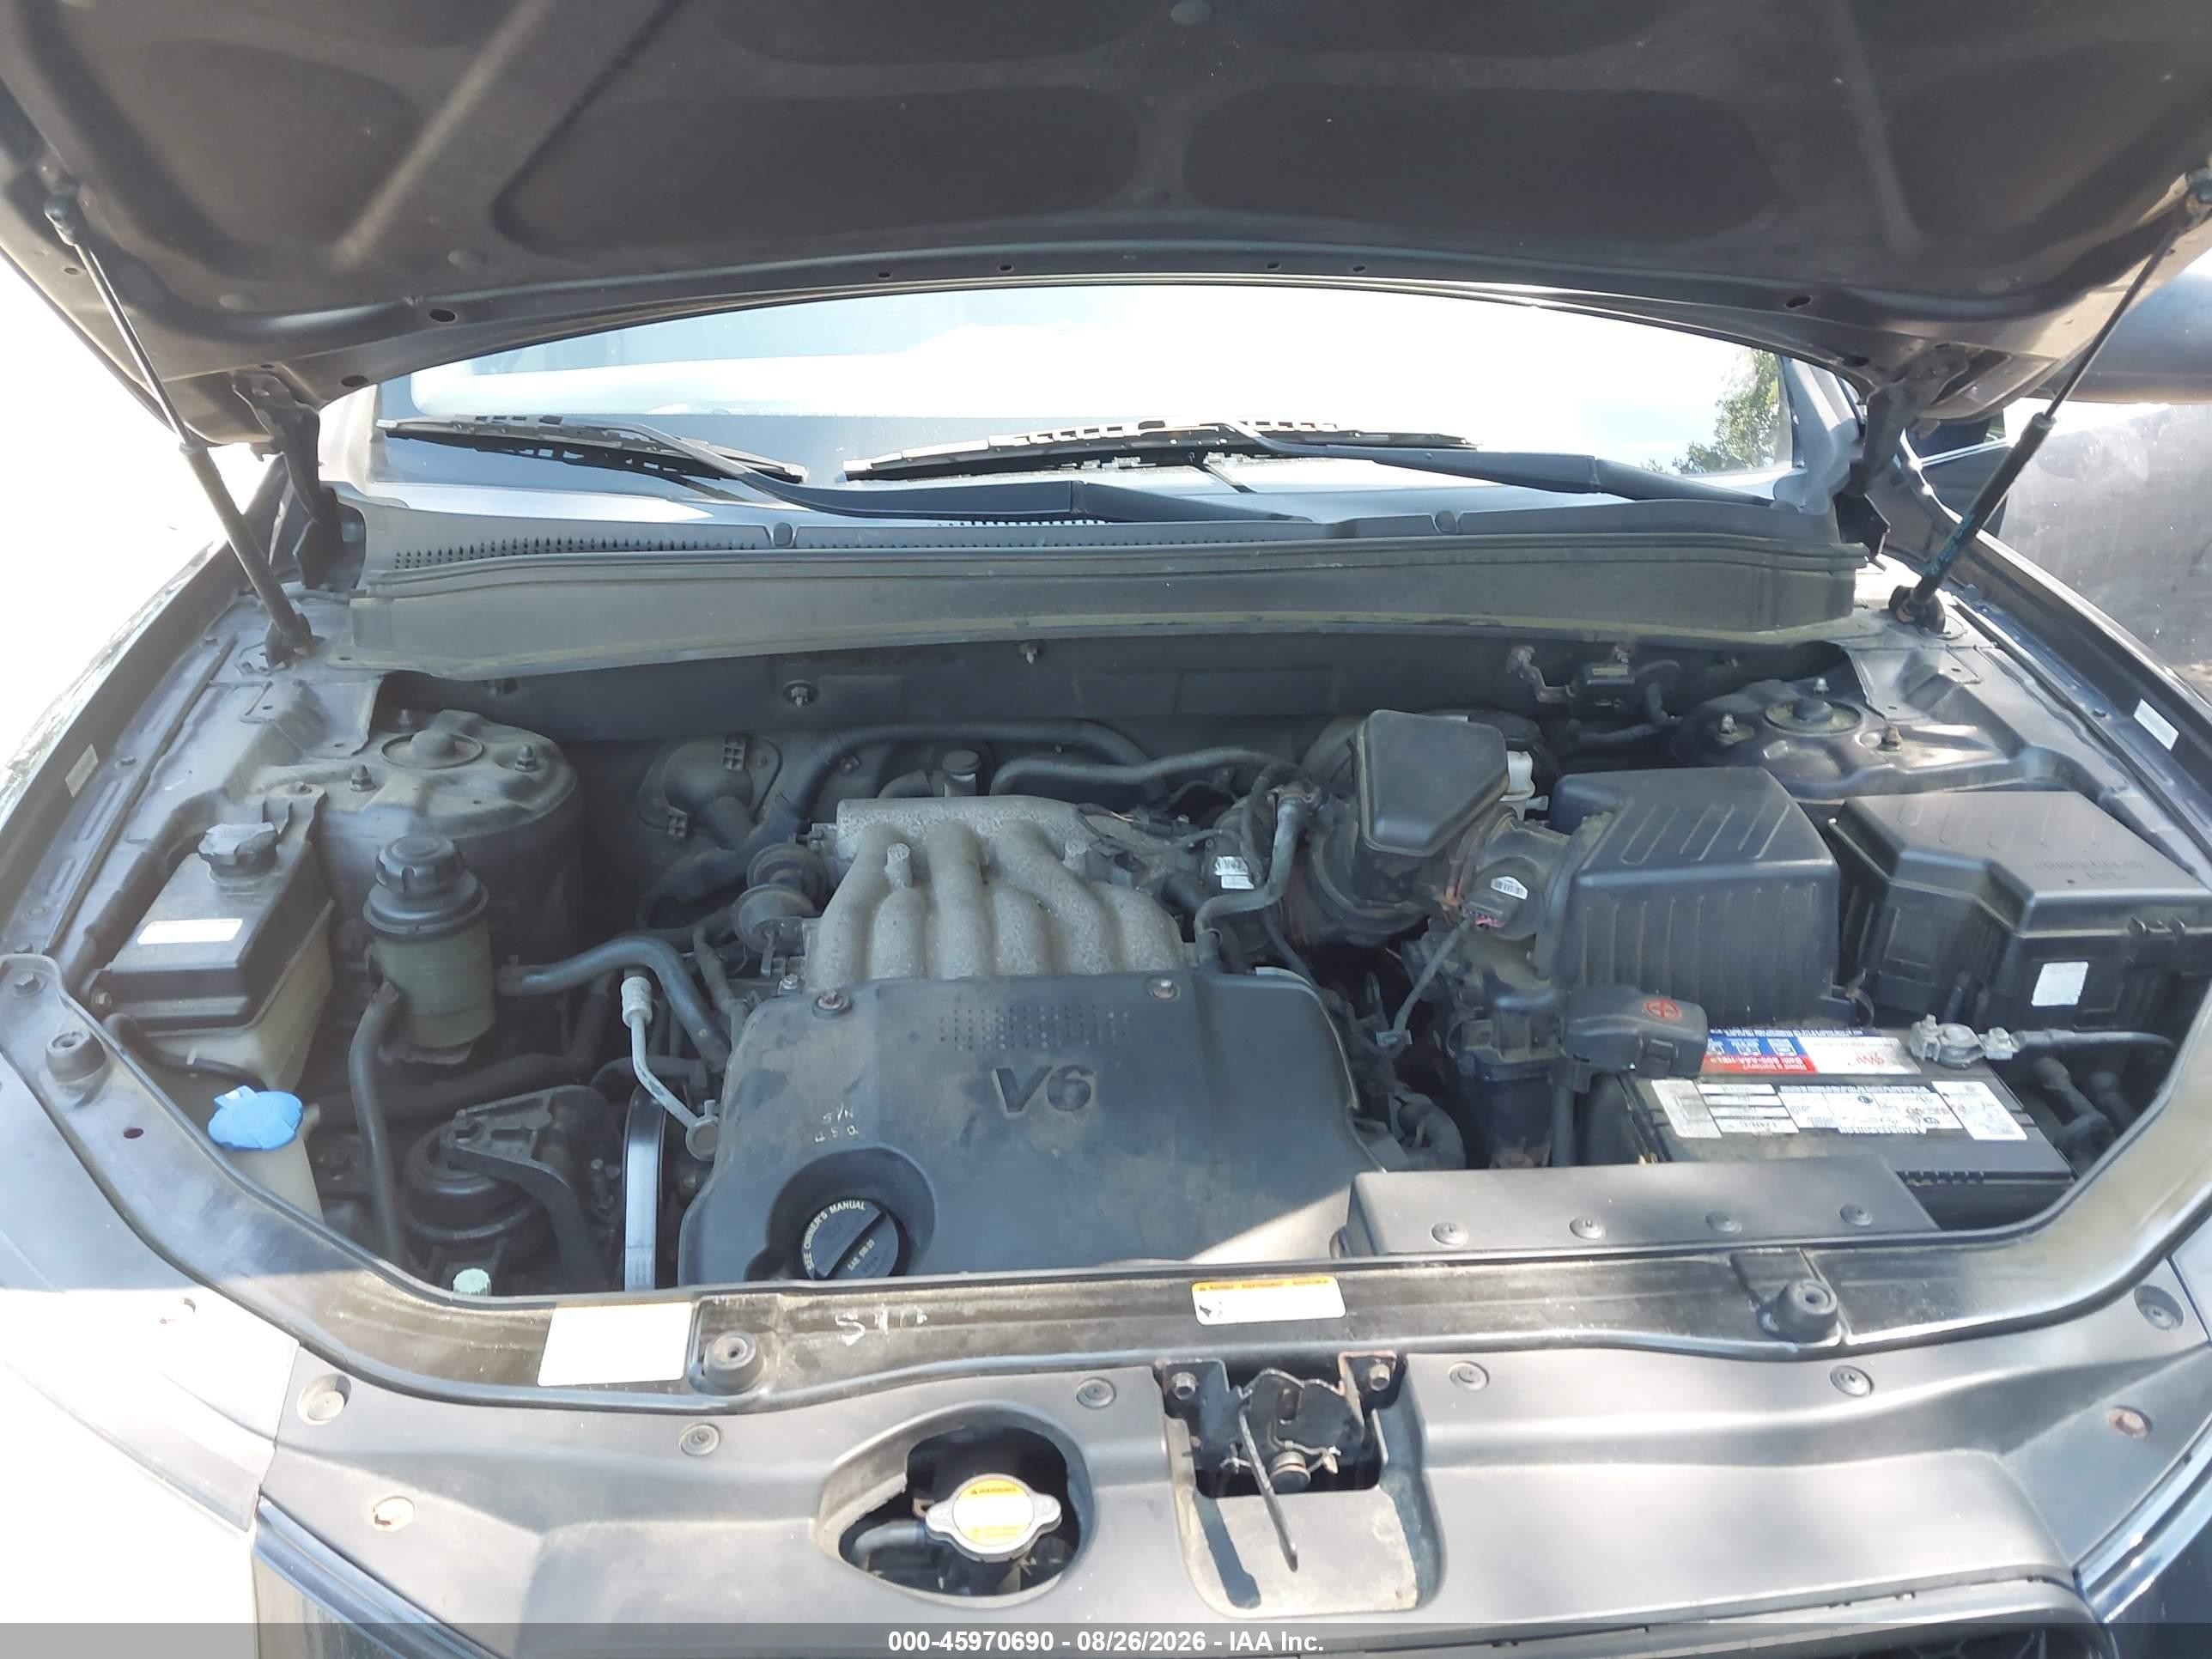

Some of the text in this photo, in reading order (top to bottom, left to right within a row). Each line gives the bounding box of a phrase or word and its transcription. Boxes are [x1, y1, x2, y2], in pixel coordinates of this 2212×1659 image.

[991, 1064, 1095, 1118] V6
[803, 1199, 866, 1271] SEE OWNER'S MANUAL
